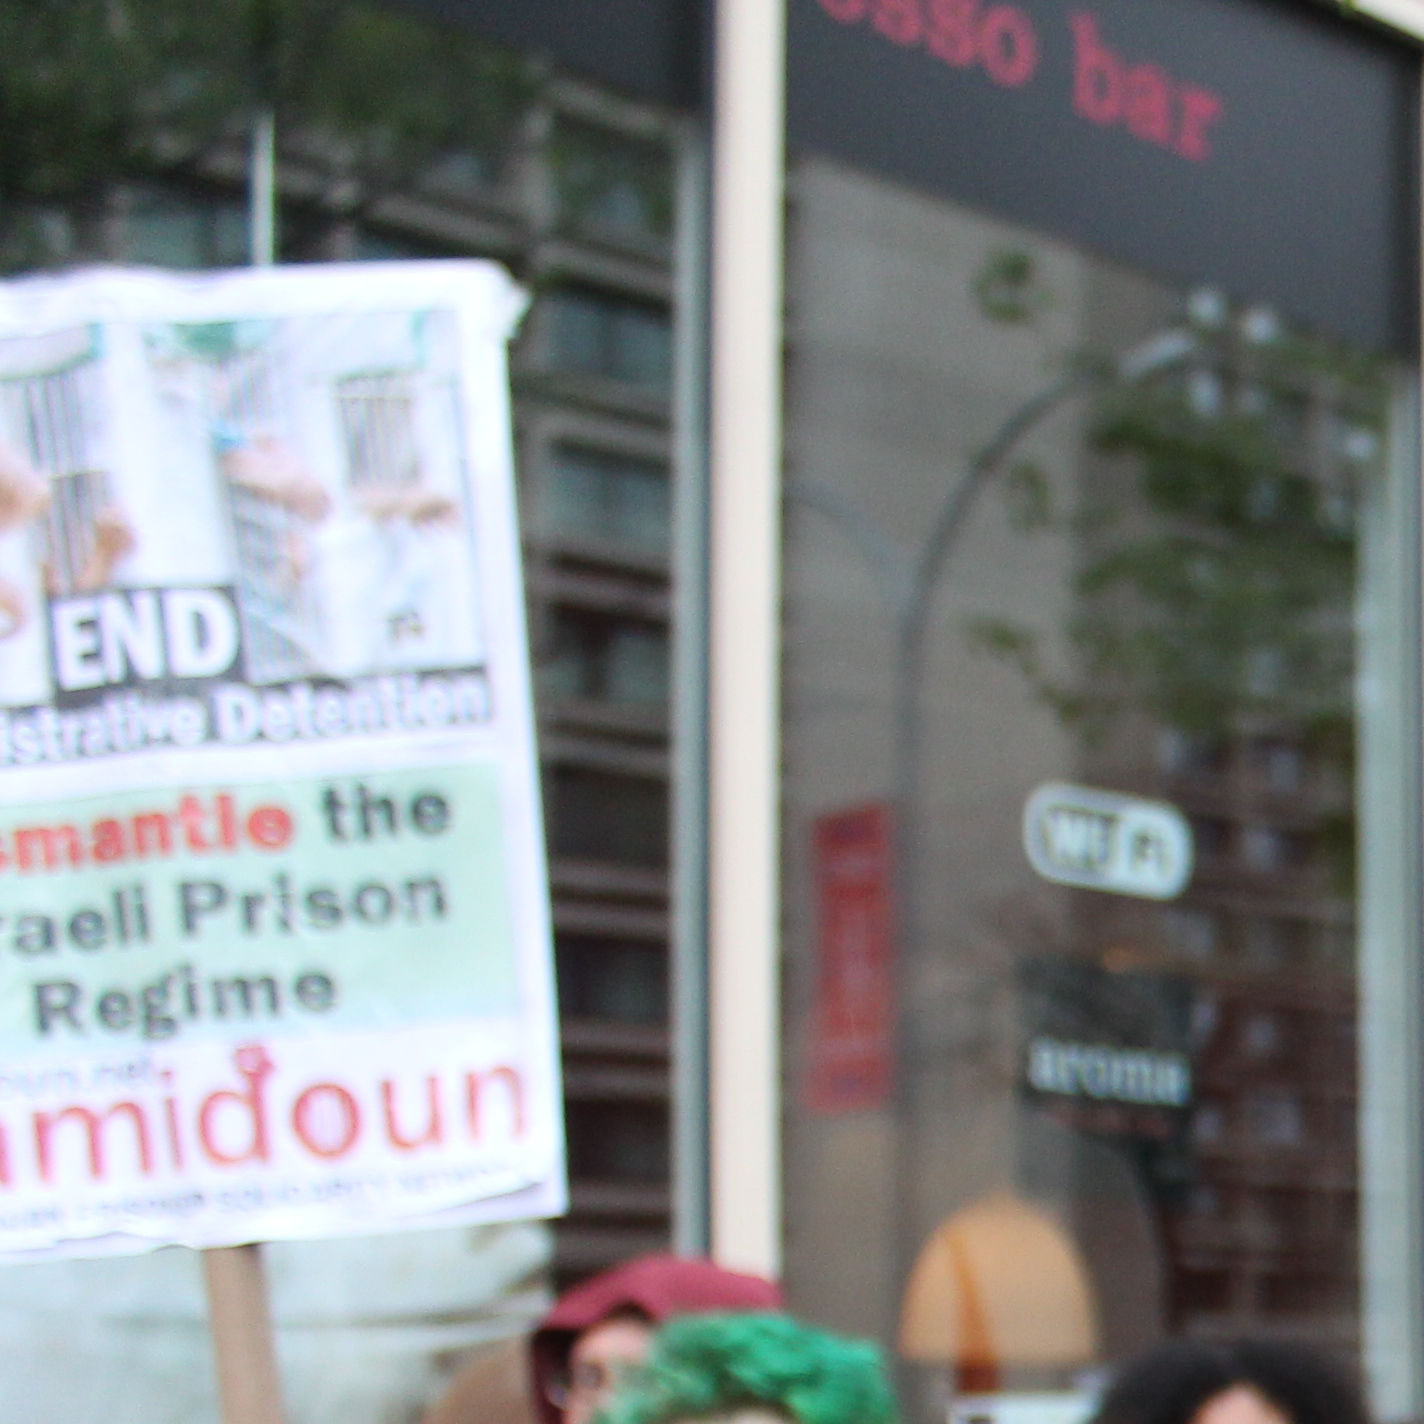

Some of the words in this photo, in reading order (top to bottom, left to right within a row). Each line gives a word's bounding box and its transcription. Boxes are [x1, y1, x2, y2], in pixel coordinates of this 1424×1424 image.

[1068, 10, 1222, 162] bar
[52, 587, 239, 691] END
[217, 674, 491, 745] Detention
[322, 783, 451, 843] the
[0, 881, 151, 956] aeli
[179, 871, 449, 938] Prison
[33, 963, 337, 1041] Regime
